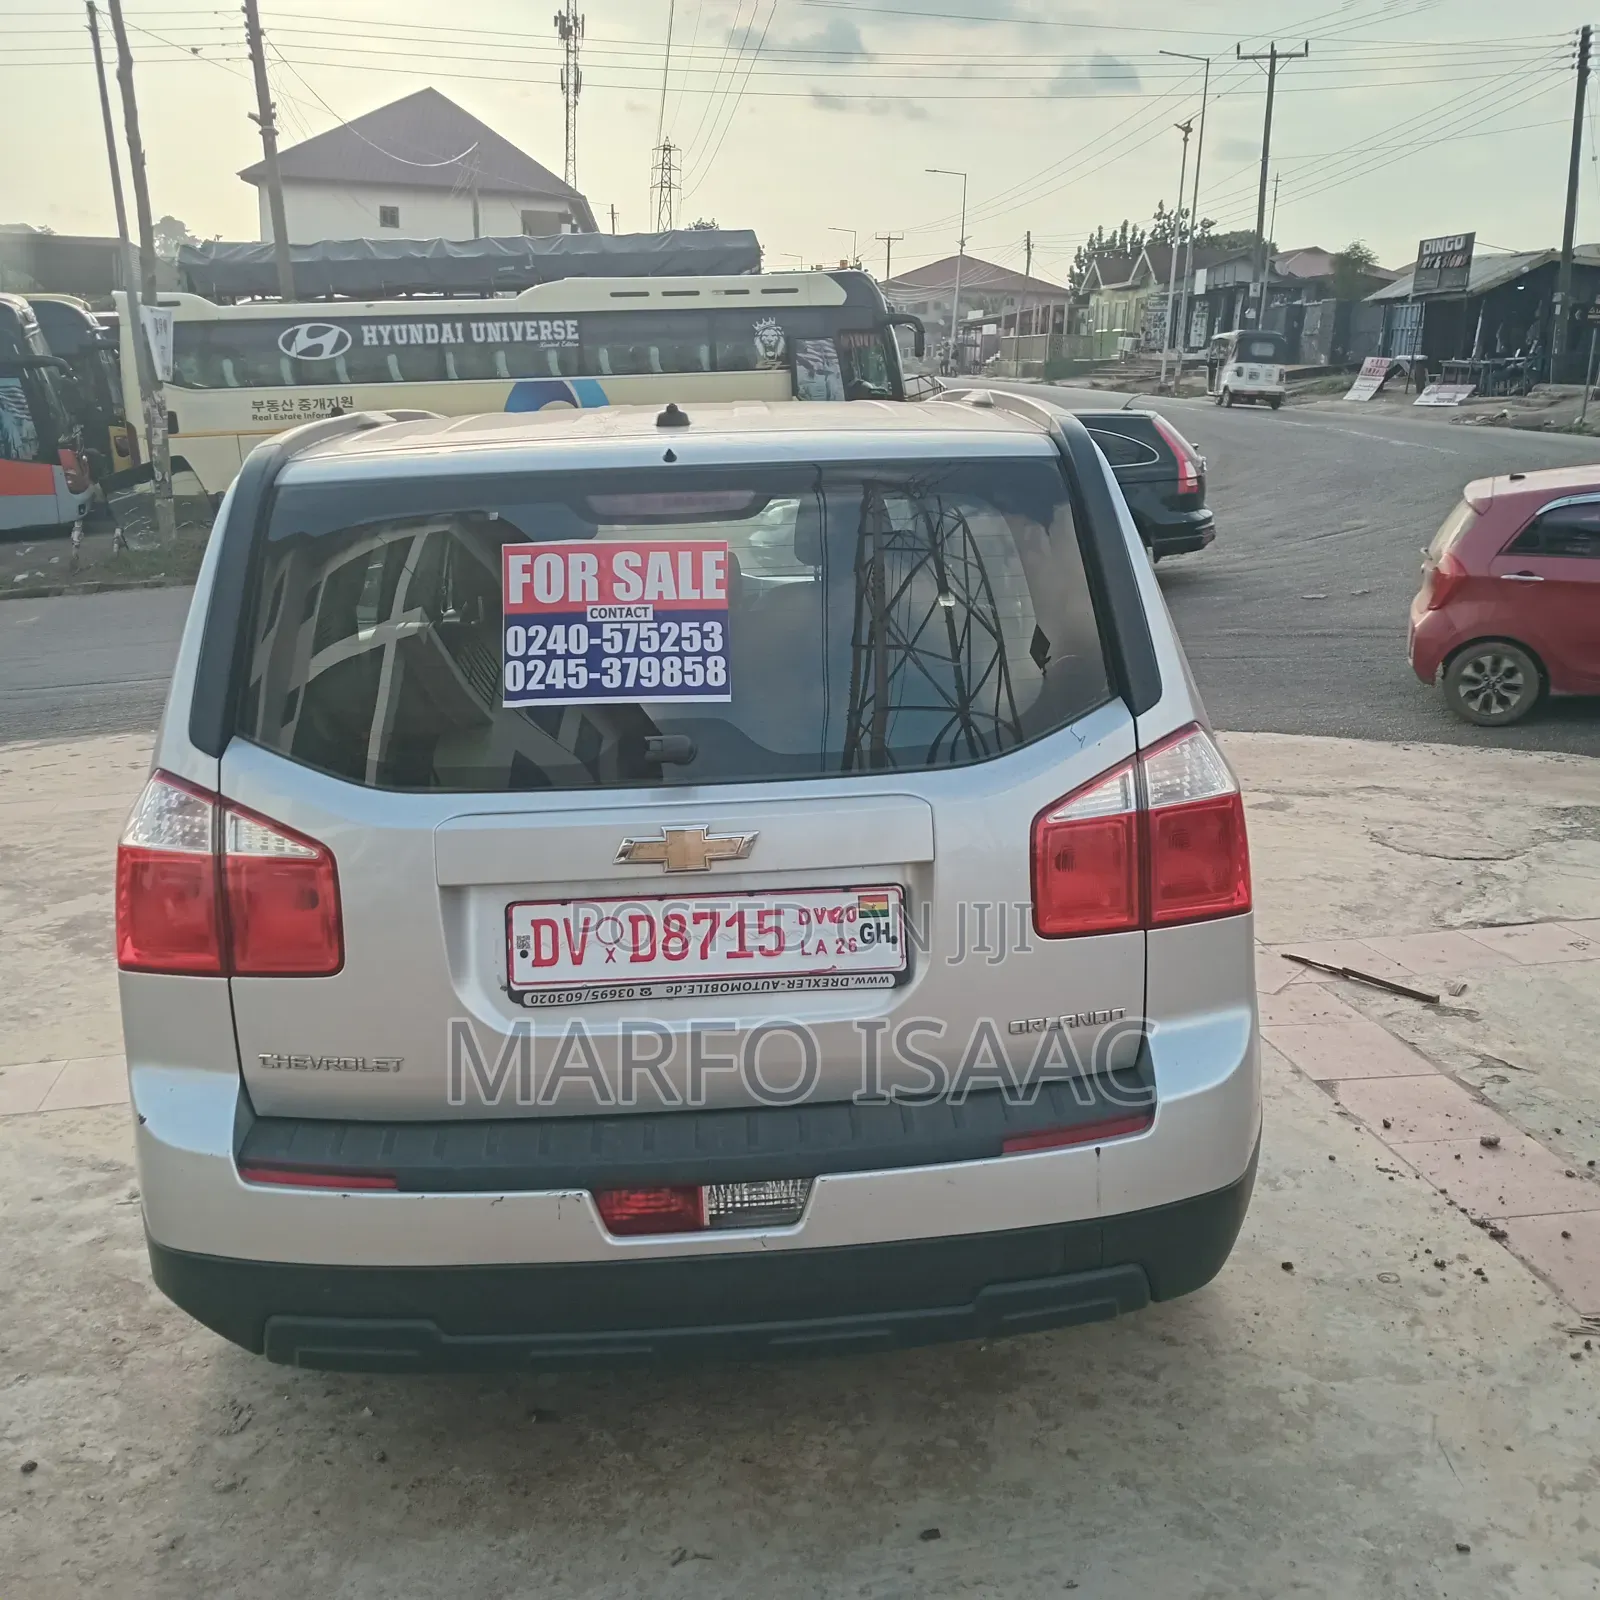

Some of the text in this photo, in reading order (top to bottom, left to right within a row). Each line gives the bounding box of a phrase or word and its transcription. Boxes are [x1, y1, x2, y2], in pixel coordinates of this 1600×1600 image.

[1423, 235, 1466, 255] DINGO
[361, 319, 579, 346] HYUNDAI UNIVERSE
[252, 396, 354, 413] 부동산 중개지원
[252, 413, 272, 421] Real
[274, 412, 302, 420] Estate
[508, 550, 726, 604] FOR SALE
[590, 606, 650, 619] CONTACT
[506, 621, 724, 657] 0240-575253
[504, 655, 727, 692] 0245-379858
[531, 908, 786, 967] DV D8715
[800, 937, 858, 956] LA 26
[530, 987, 635, 1005] 03695/603020
[1009, 1007, 1126, 1034] ORLANDO
[258, 1053, 405, 1073] CHEVROLET
